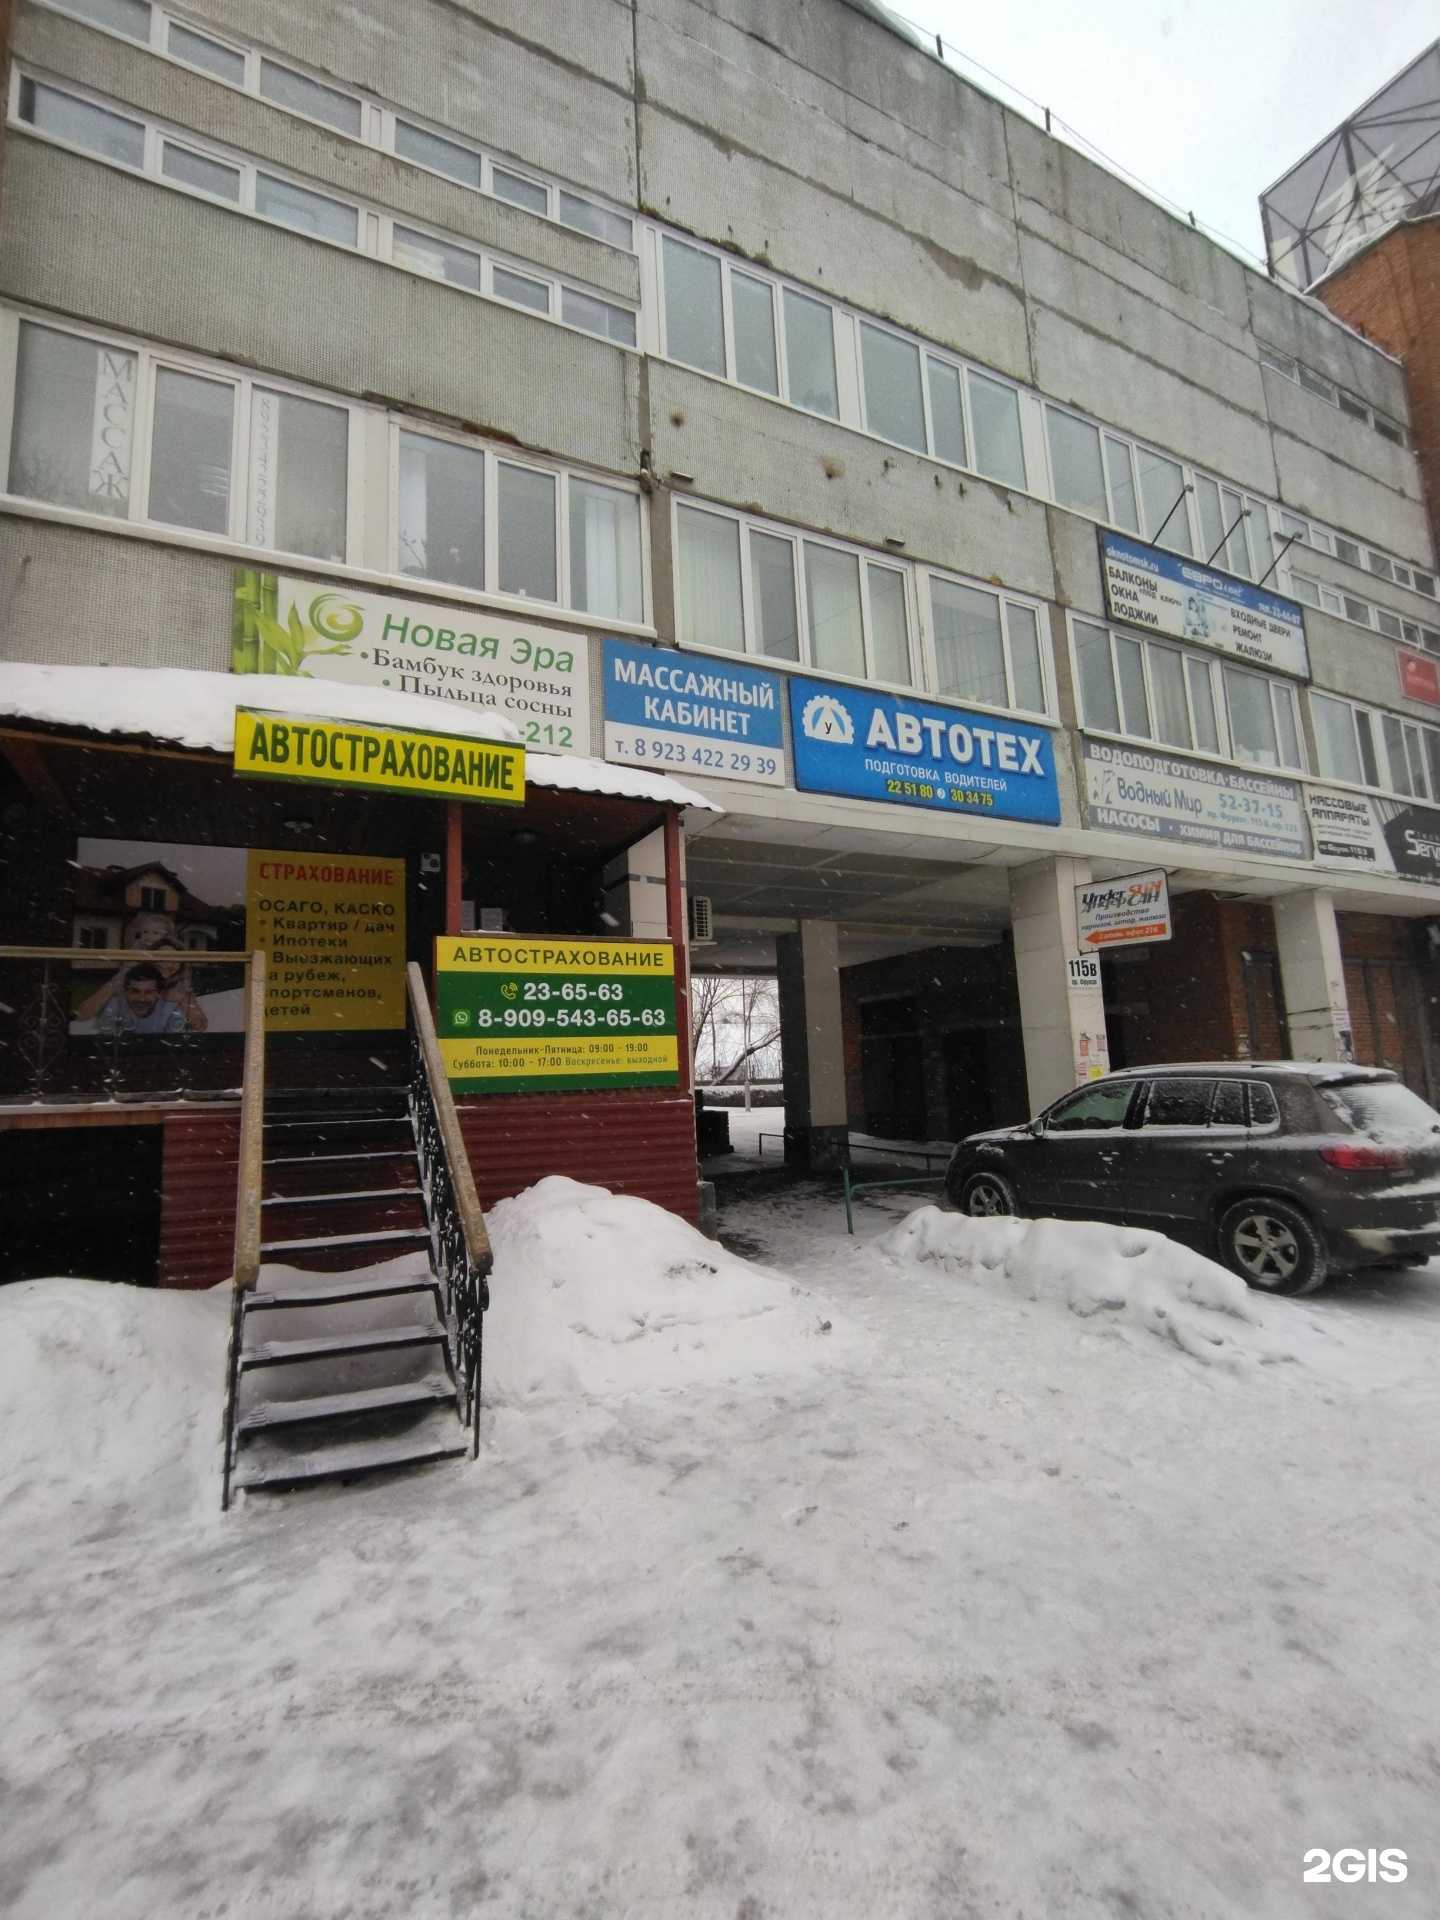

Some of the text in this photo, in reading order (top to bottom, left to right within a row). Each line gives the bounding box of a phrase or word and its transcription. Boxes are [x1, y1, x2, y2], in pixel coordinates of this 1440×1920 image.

[1108, 566, 1157, 592] БАЛКОНЫ
[1111, 584, 1139, 602] ОКНА
[1113, 602, 1159, 625] ЛОДЖИИ
[382, 613, 574, 673] Новая Эра
[372, 648, 572, 697] Бамбук здоровья
[614, 657, 775, 710] МАССАЖНЫЙ
[400, 675, 572, 718] Пыльца сосны
[645, 695, 751, 736] КАБИНЕТ
[866, 708, 1046, 777] АВТОТЕХ
[250, 722, 514, 791] АВТОСТРАХОВАНИЕ
[634, 737, 646, 757] 8
[651, 740, 685, 763] 923
[692, 747, 724, 769] 422
[730, 753, 751, 773] 29
[756, 757, 777, 776] 39
[1090, 744, 1225, 787] ВОДОПОДГОТОВКА
[865, 758, 1007, 792] ПОДГОТОВКА ВОДИТЕЛЕЙ
[1117, 776, 1202, 818] Водный Мир
[1097, 807, 1160, 832] НАСОСЫ
[259, 863, 395, 885] СТРАХОВАНИЕ
[259, 900, 395, 916] ОСАГО, КАСКО
[273, 918, 348, 932] Квартир
[364, 922, 395, 933] дач
[272, 934, 348, 947] Ипотеки
[273, 951, 392, 966] Выезжающих
[453, 947, 663, 967] АВТОСТРАХОВАНИЕ
[284, 969, 346, 983] рубеж,
[266, 987, 381, 1000] портсменов,
[524, 982, 623, 1001] 23-65-63
[478, 1008, 666, 1027] 8-909-543-65-63
[588, 1043, 614, 1053] 09:00
[625, 1043, 648, 1052] 19:00
[452, 1058, 495, 1069] Суббота:
[499, 1058, 525, 1068] 10:00
[537, 1056, 561, 1067] 17:00
